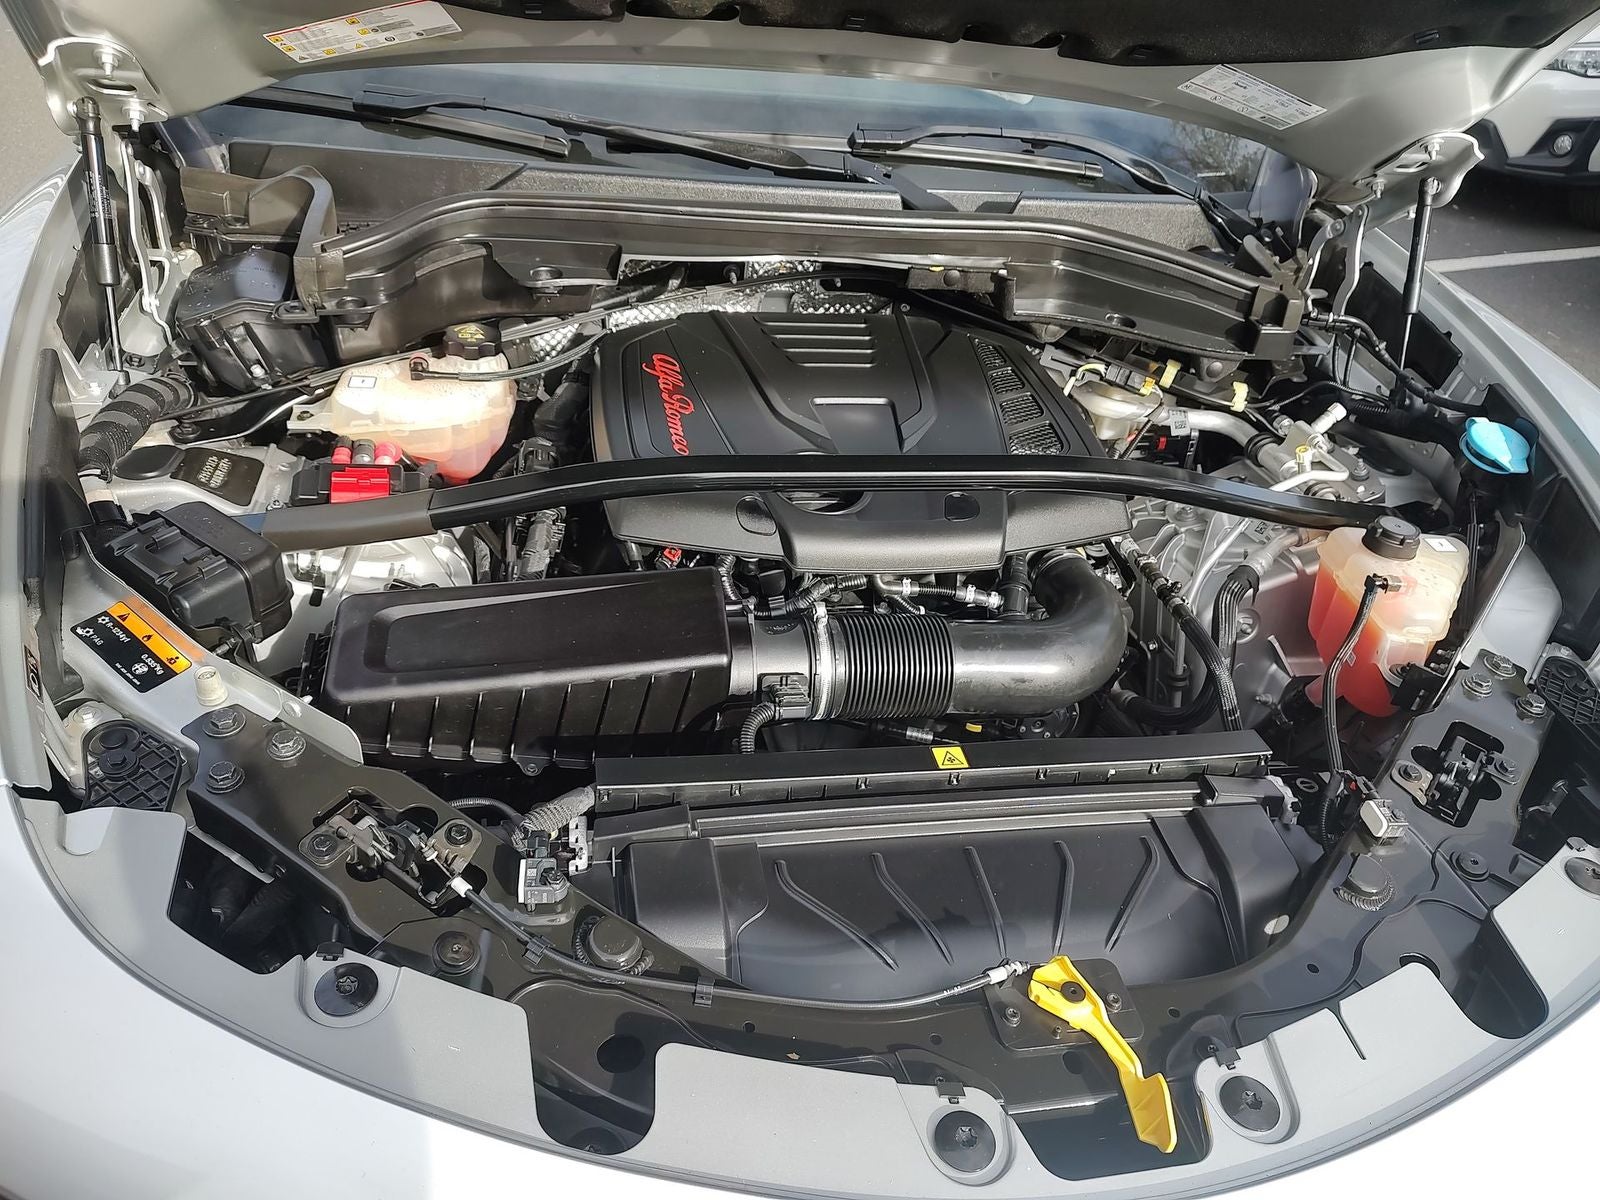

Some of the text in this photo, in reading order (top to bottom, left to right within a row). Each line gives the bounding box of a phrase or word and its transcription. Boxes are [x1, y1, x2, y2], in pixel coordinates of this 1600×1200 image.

[641, 353, 695, 456] Alfa Romeo
[89, 634, 105, 646] PAG
